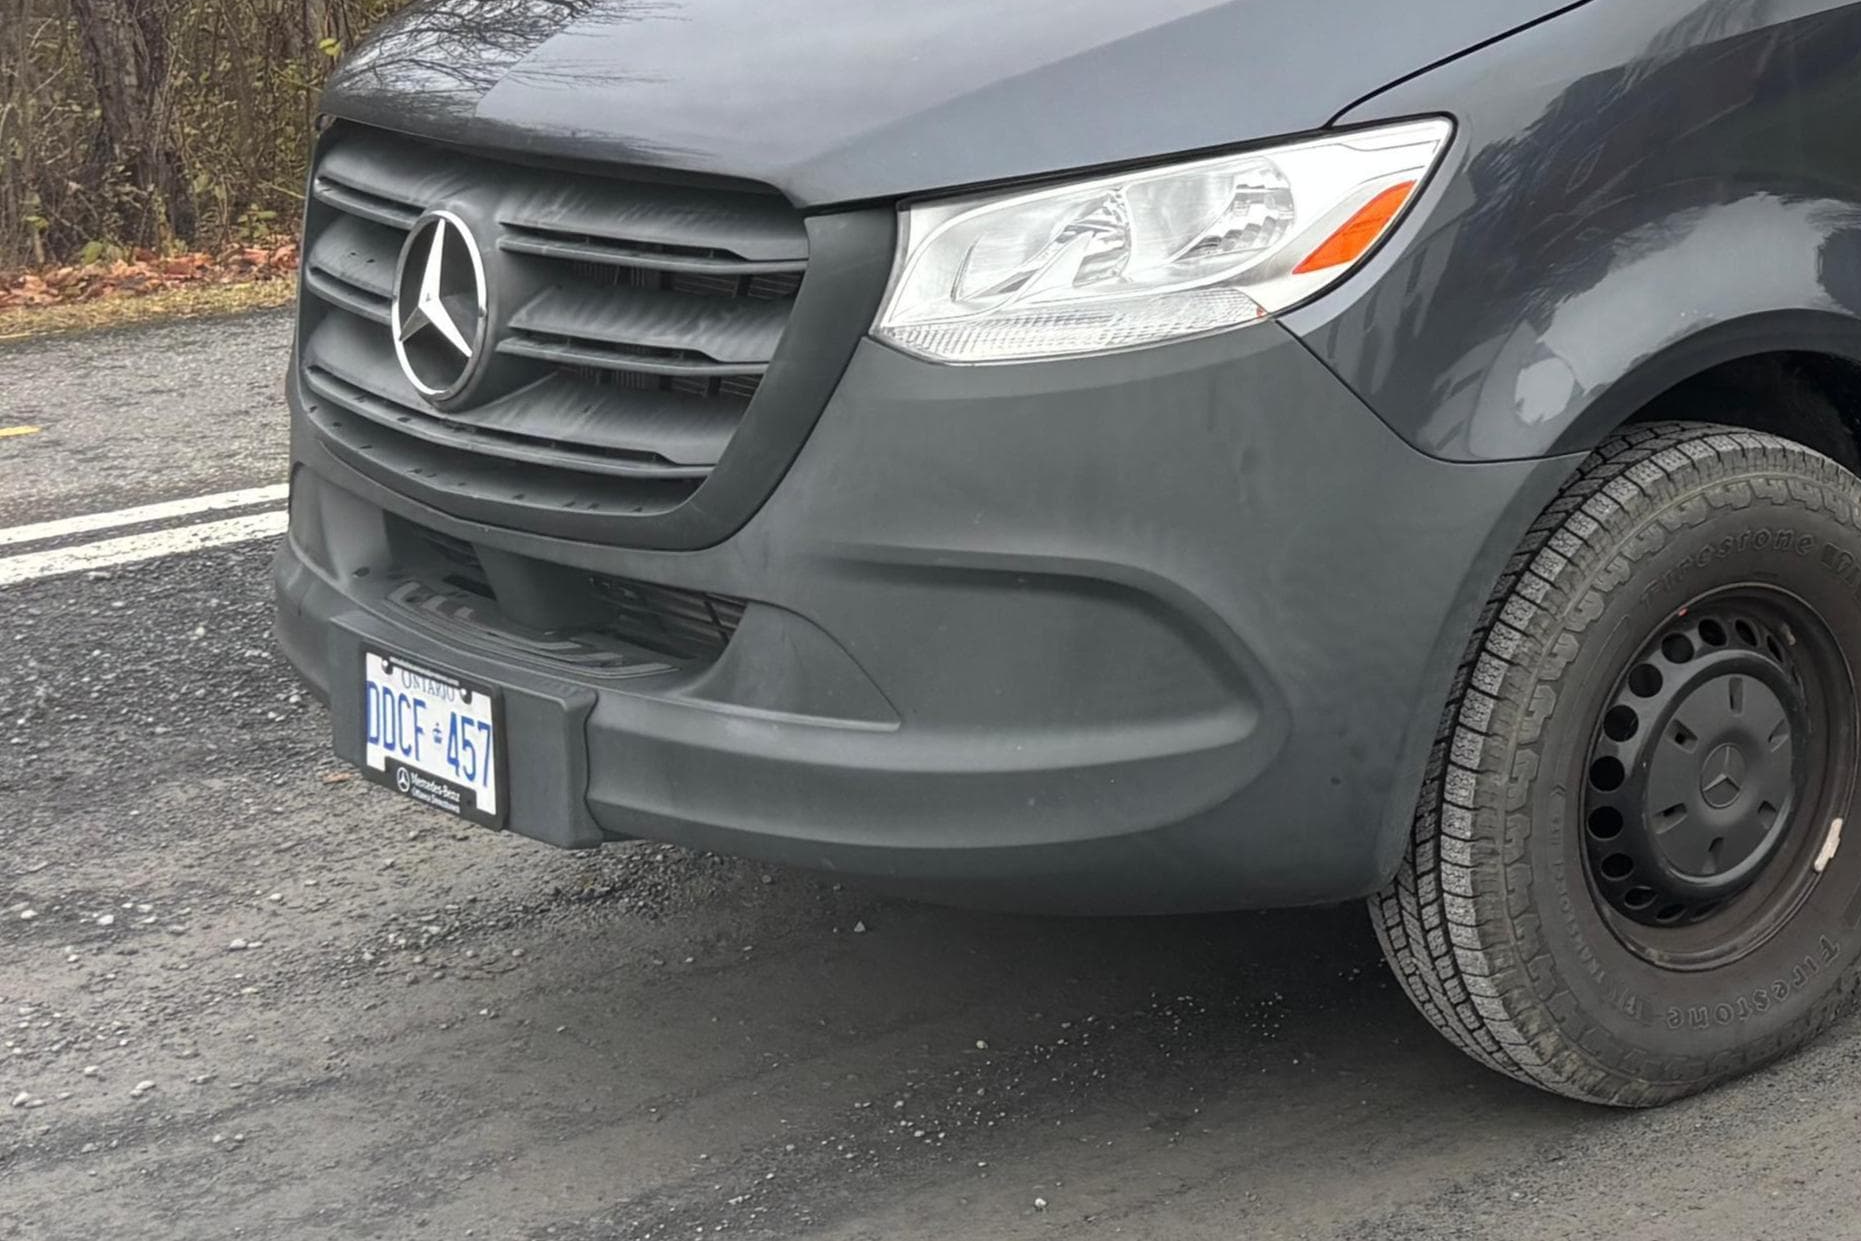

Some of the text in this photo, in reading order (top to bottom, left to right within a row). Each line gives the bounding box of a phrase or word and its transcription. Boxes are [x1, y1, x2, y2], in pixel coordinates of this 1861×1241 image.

[1641, 527, 1816, 607] Firestone
[366, 680, 492, 788] DDCF 457
[1665, 934, 1842, 1030] Firestone
